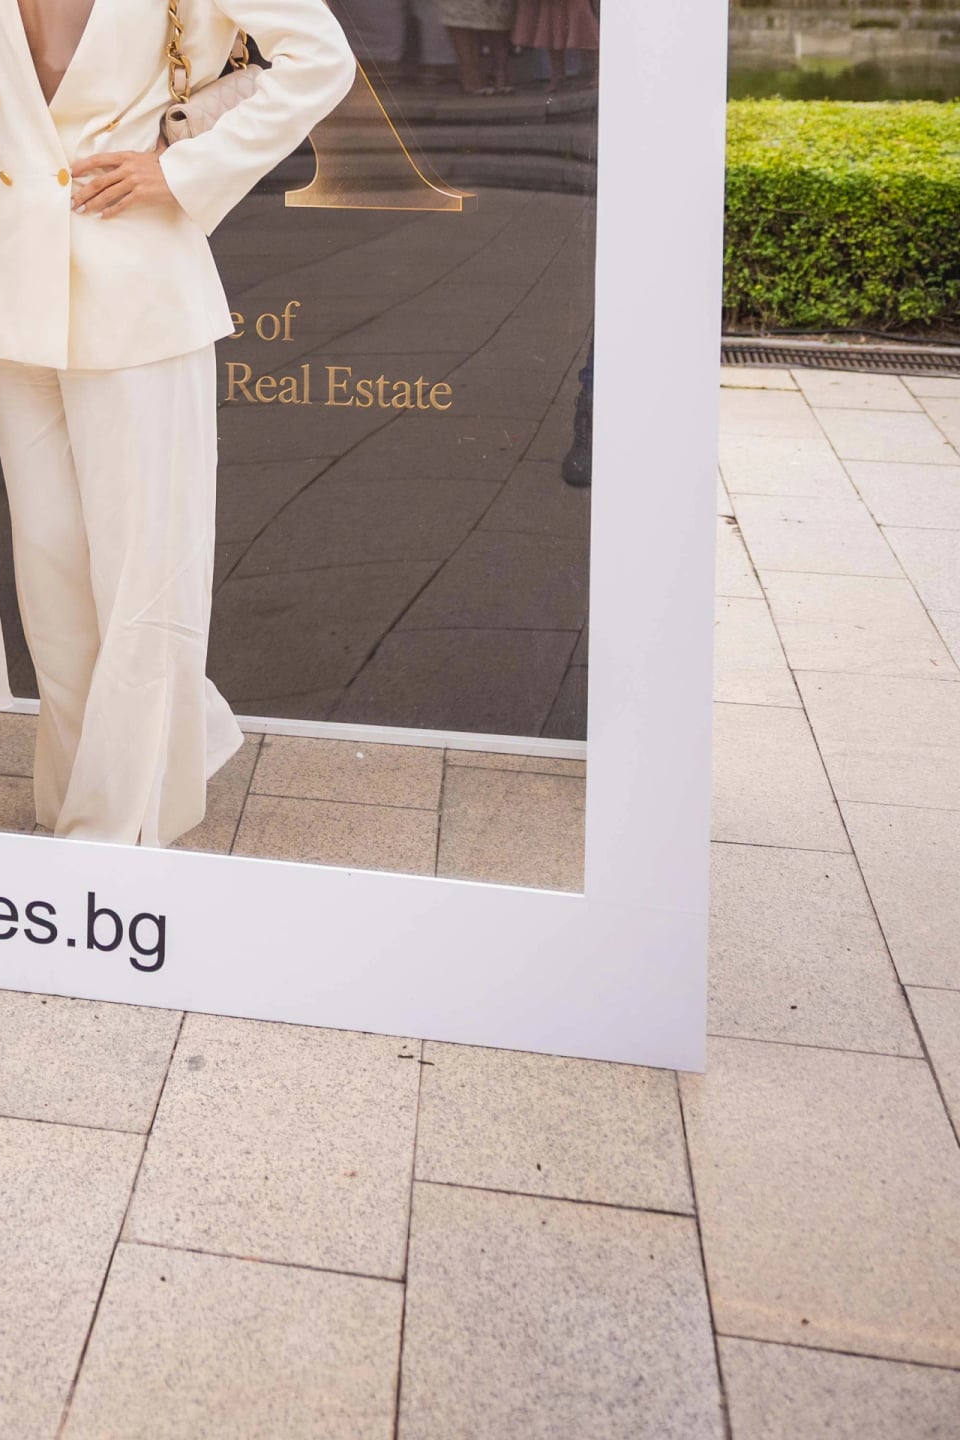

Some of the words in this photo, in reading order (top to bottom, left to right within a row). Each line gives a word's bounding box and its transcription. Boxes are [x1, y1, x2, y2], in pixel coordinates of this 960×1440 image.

[255, 300, 301, 342] of
[224, 362, 312, 405] Real
[324, 365, 453, 411] Estate
